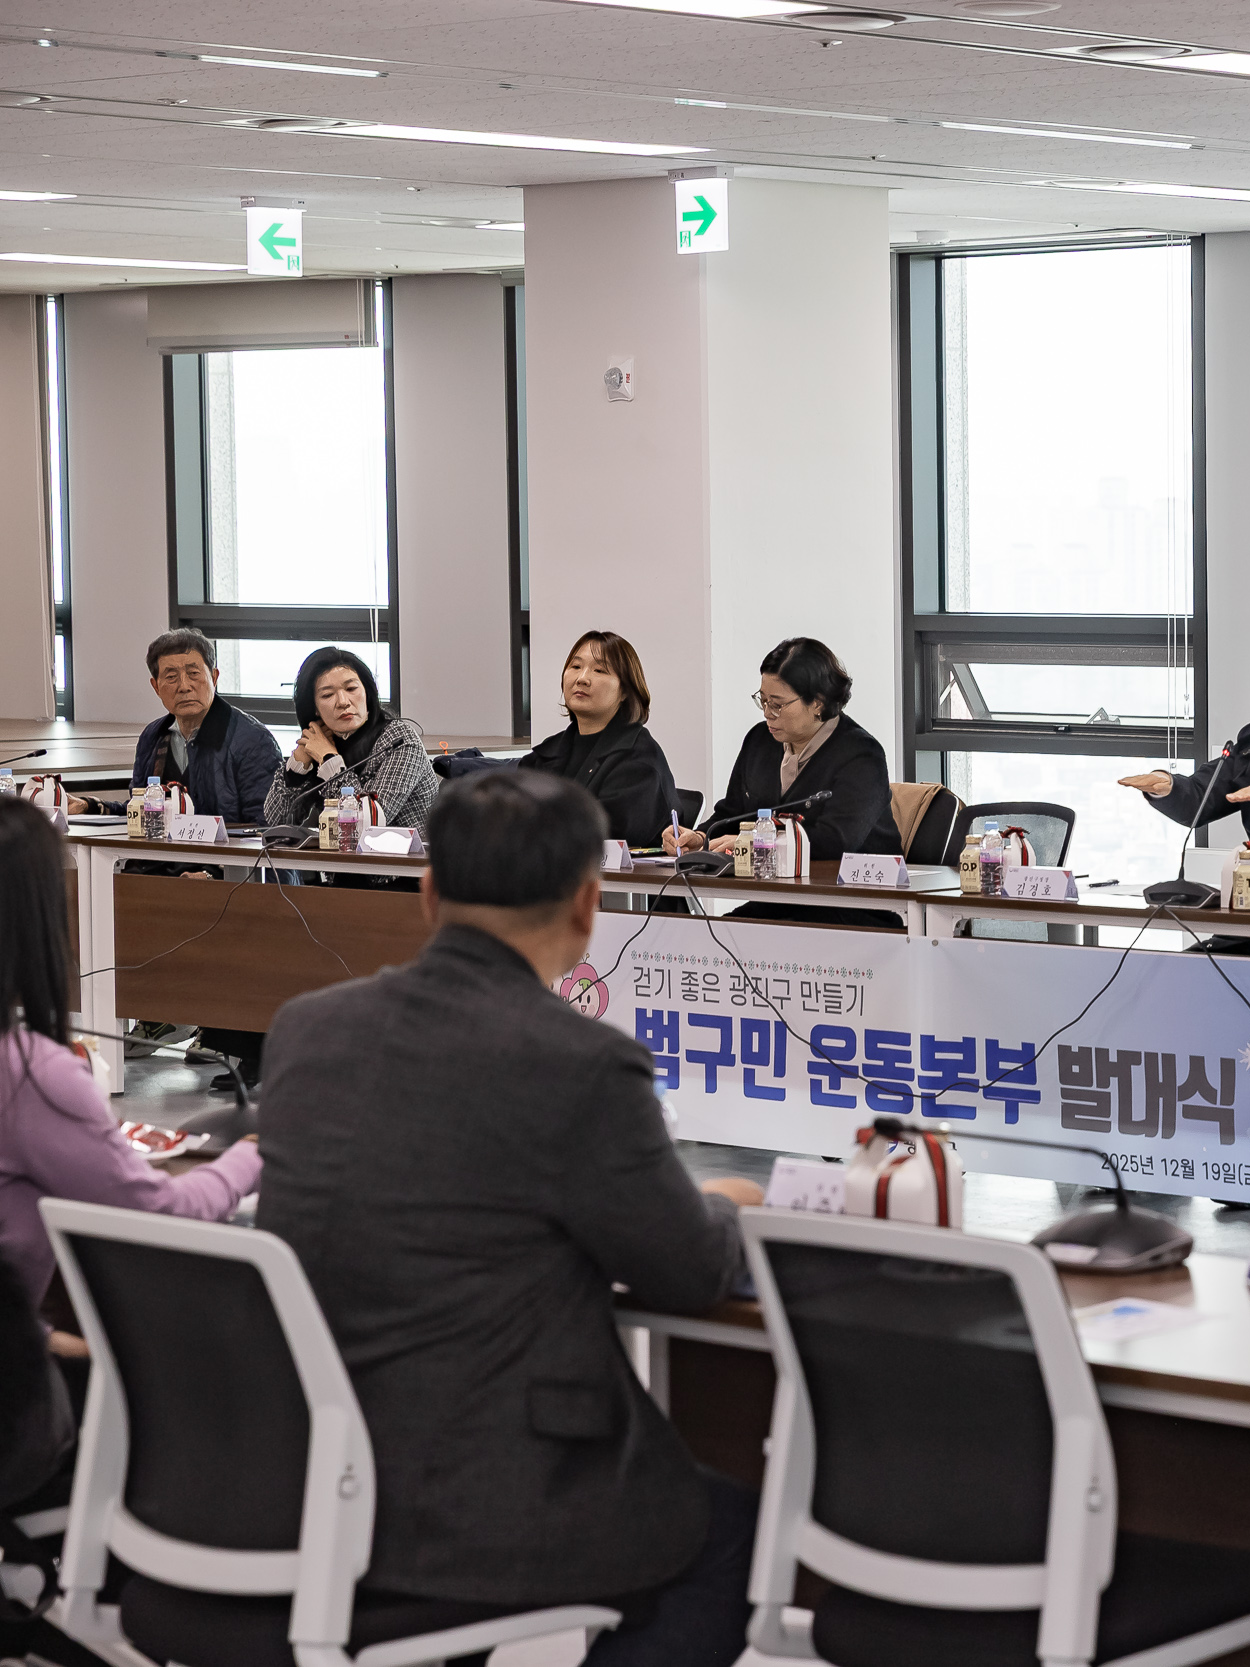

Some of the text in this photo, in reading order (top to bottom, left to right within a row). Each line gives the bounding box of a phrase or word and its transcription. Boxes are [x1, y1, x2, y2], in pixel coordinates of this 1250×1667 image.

[850, 869, 884, 883] 진은숙
[1016, 882, 1051, 897] 김경호
[632, 965, 865, 1016] 걷기 좋은 광진구 만들기
[635, 1007, 1237, 1146] 범구민 운동본부 발대식
[1100, 1152, 1155, 1177] 2025년
[1160, 1157, 1196, 1181] 12월
